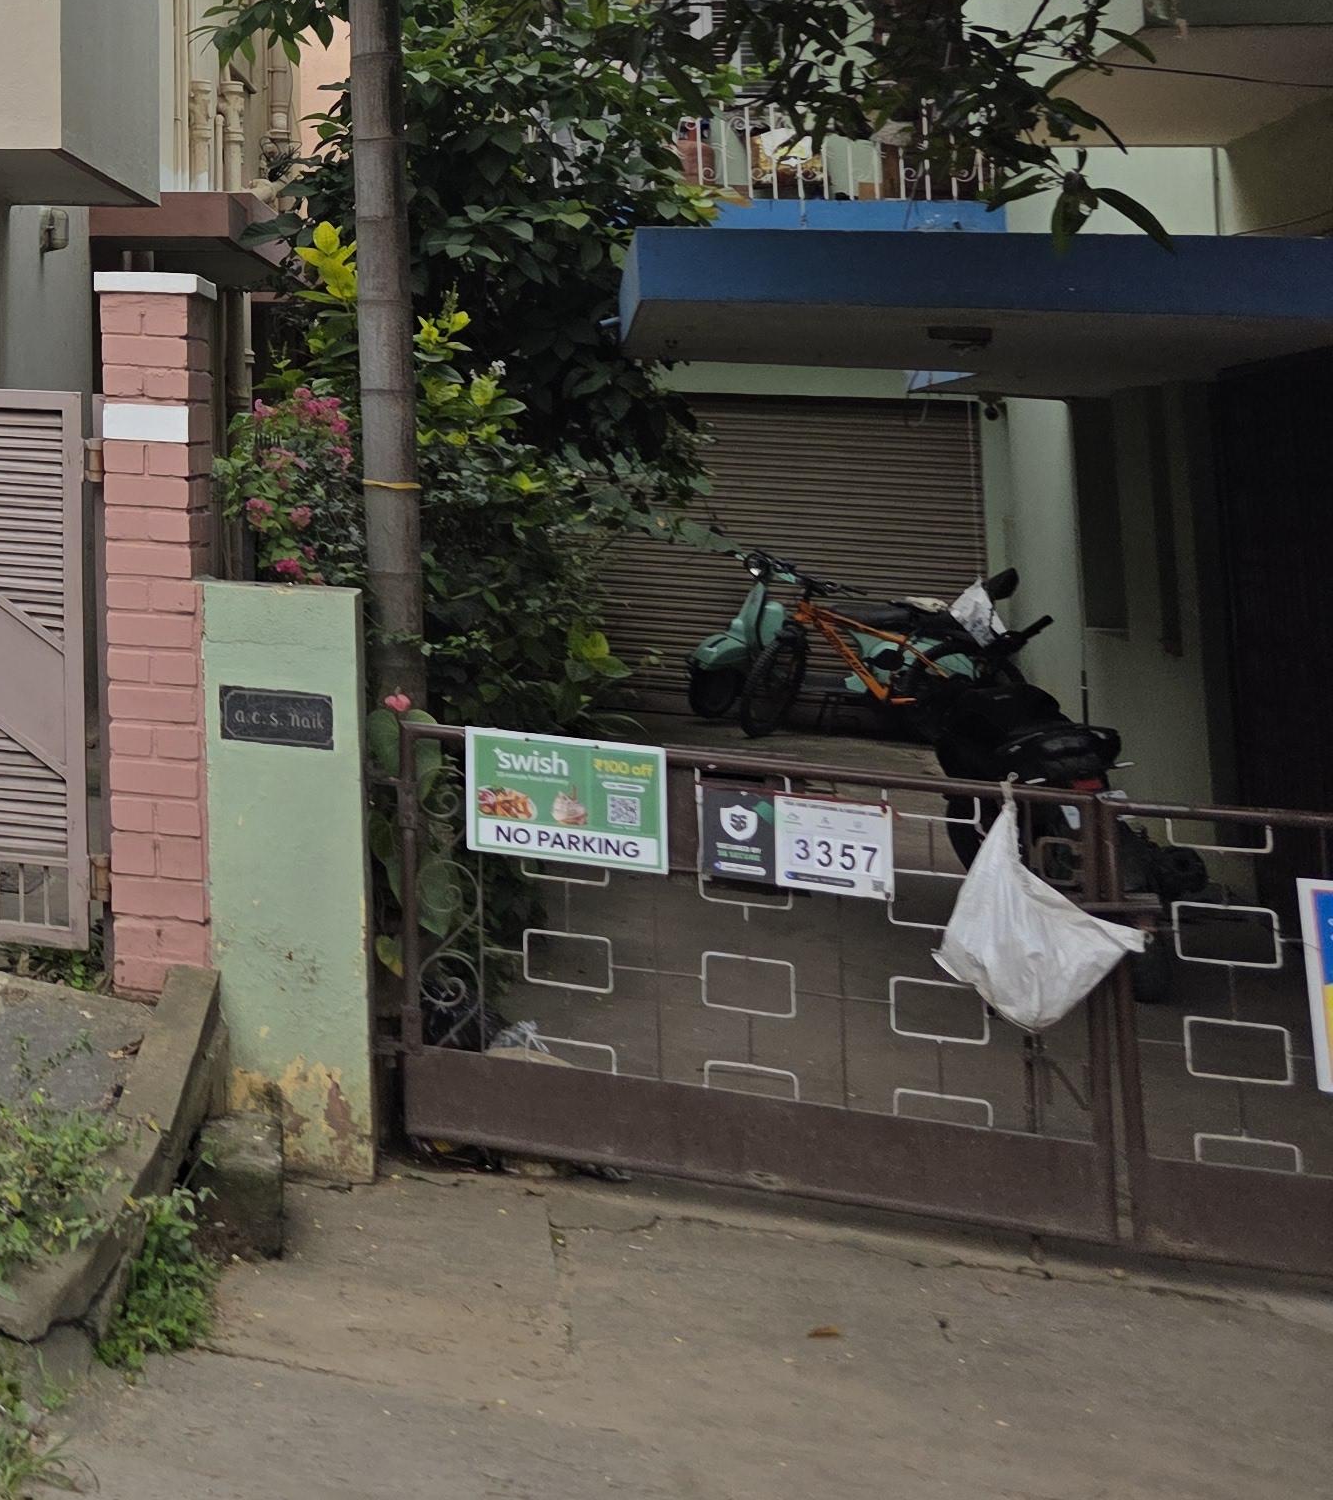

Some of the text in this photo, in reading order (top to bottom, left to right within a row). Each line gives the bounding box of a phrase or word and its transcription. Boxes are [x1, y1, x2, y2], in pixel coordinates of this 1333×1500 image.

[497, 749, 569, 777] swish
[495, 825, 640, 858] NO PARKING
[794, 838, 879, 873] 3357
